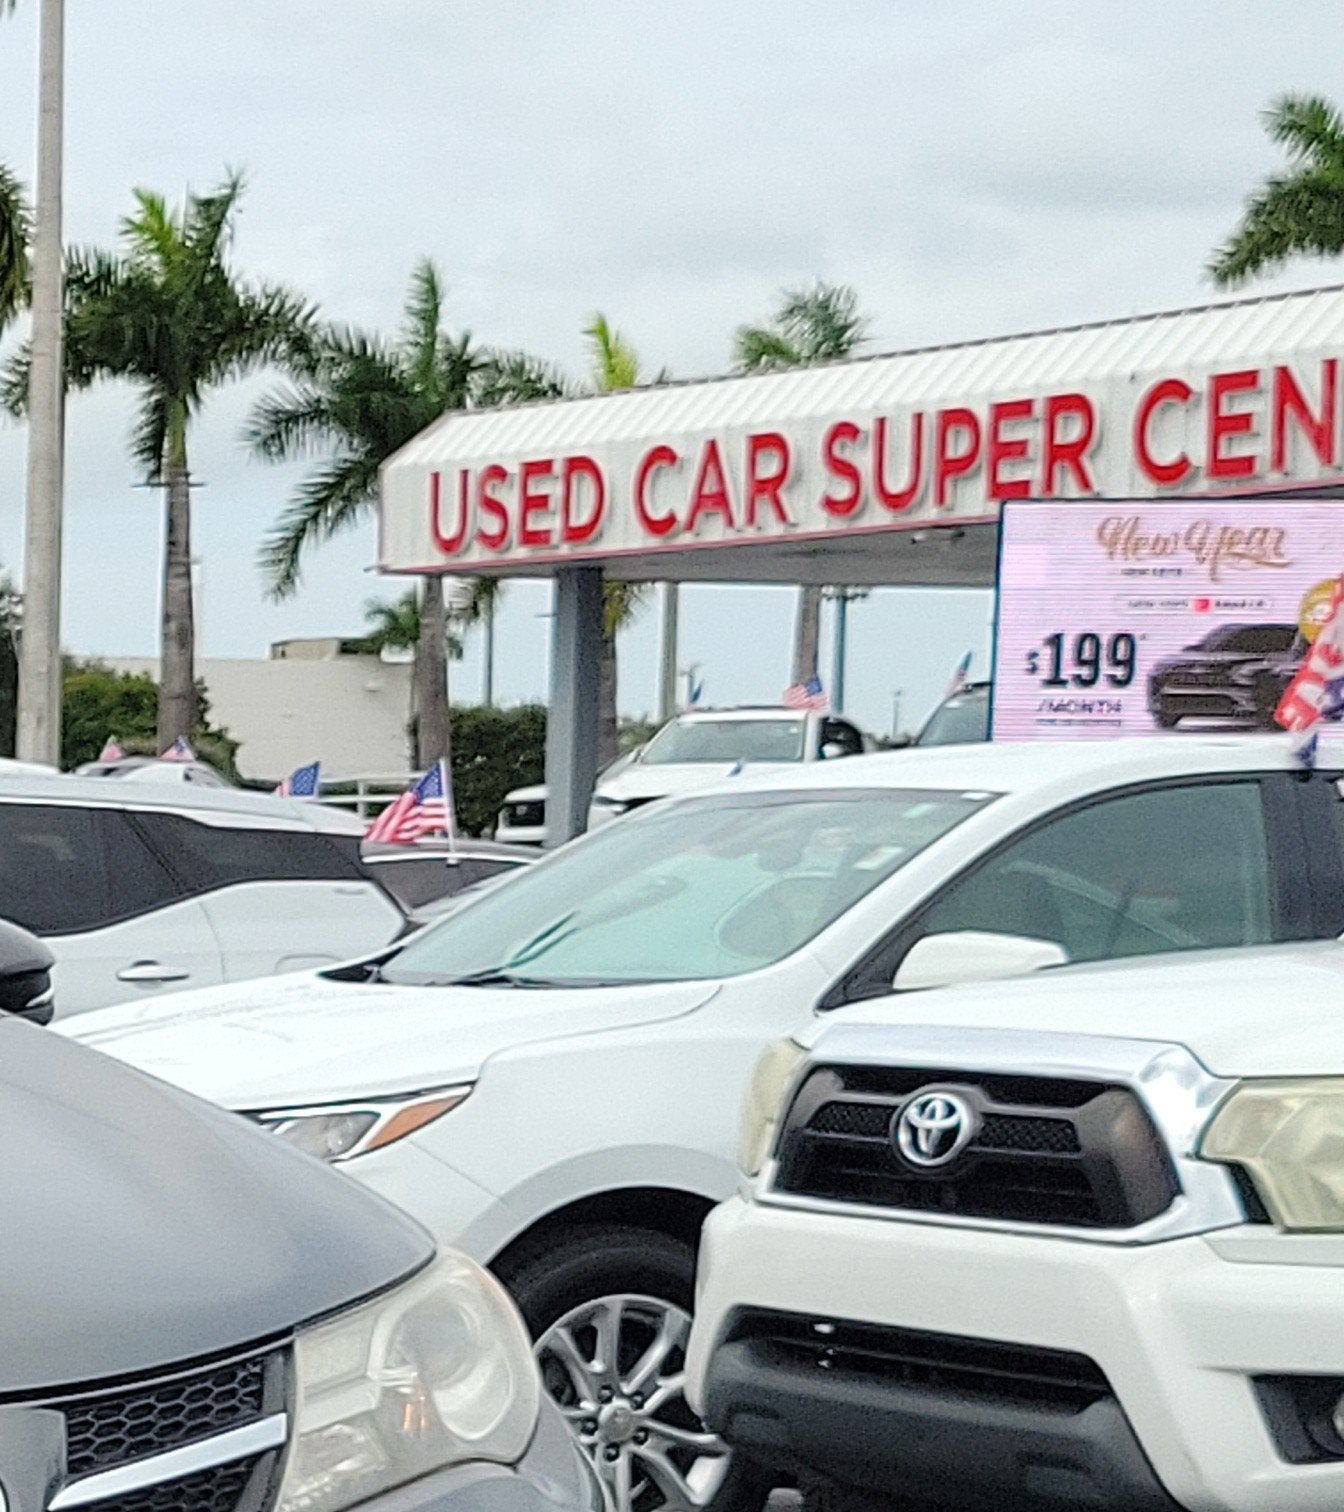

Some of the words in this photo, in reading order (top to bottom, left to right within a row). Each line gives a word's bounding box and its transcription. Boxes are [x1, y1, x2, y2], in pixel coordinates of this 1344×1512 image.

[429, 455, 605, 554] USED
[635, 432, 791, 536] CAR
[821, 393, 1095, 517] SUPER
[1097, 515, 1178, 561] New
